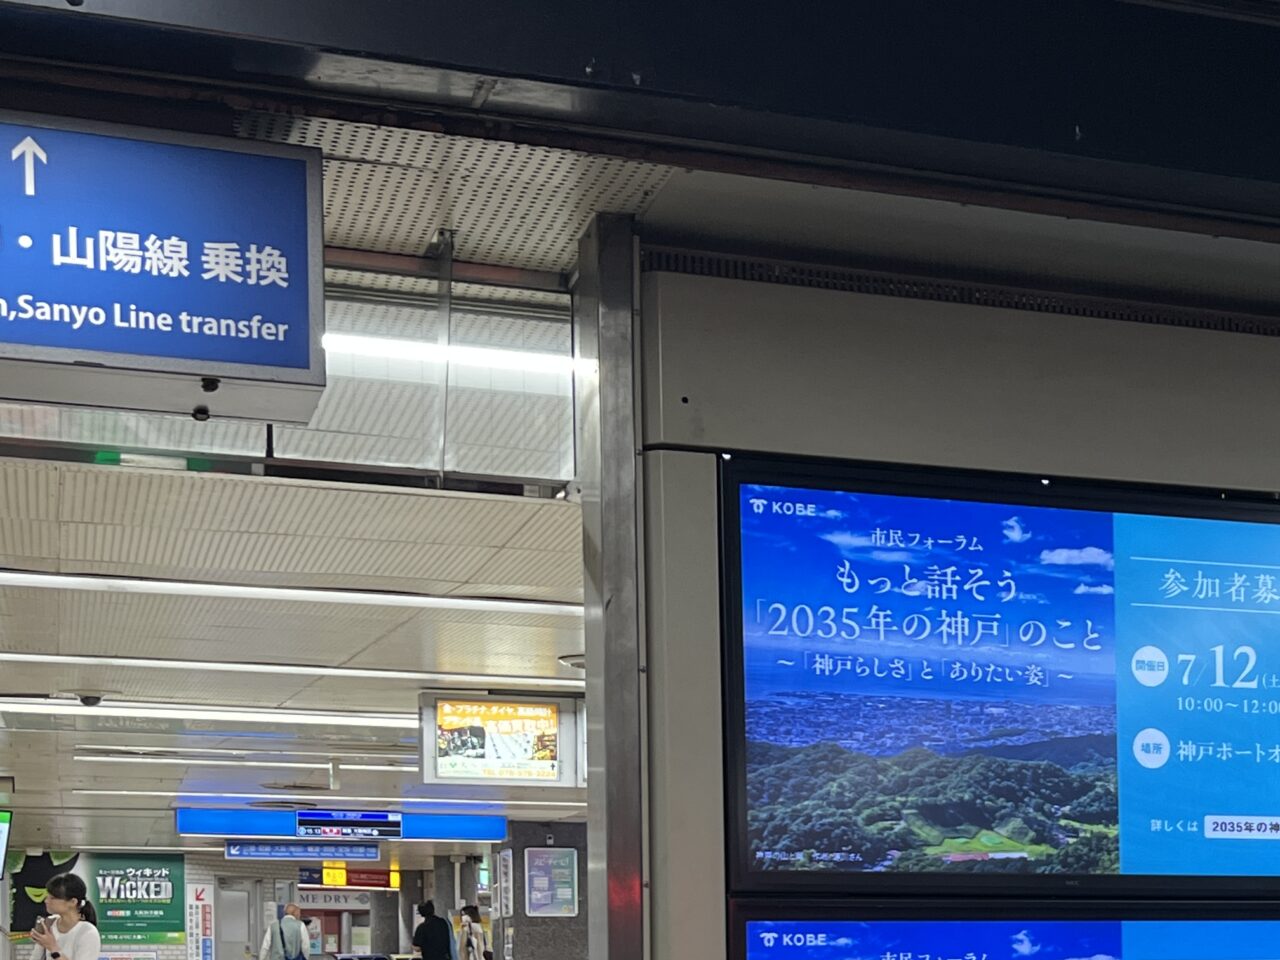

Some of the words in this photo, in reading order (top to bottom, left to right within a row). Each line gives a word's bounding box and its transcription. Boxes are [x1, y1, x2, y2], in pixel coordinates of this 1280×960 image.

[201, 242, 289, 288] 乗換
[114, 303, 173, 332] Line
[179, 311, 289, 341] transfer
[772, 501, 816, 516] KOBE
[871, 528, 983, 551] 市民フォーラム
[837, 560, 1016, 602] もっと話そう
[755, 599, 1102, 651] 「2035年の神戸」のこと
[1150, 819, 1198, 833] 詳しくは
[126, 867, 169, 877] ウィキッド
[323, 894, 351, 904] DRY
[782, 933, 826, 946] KOBE
